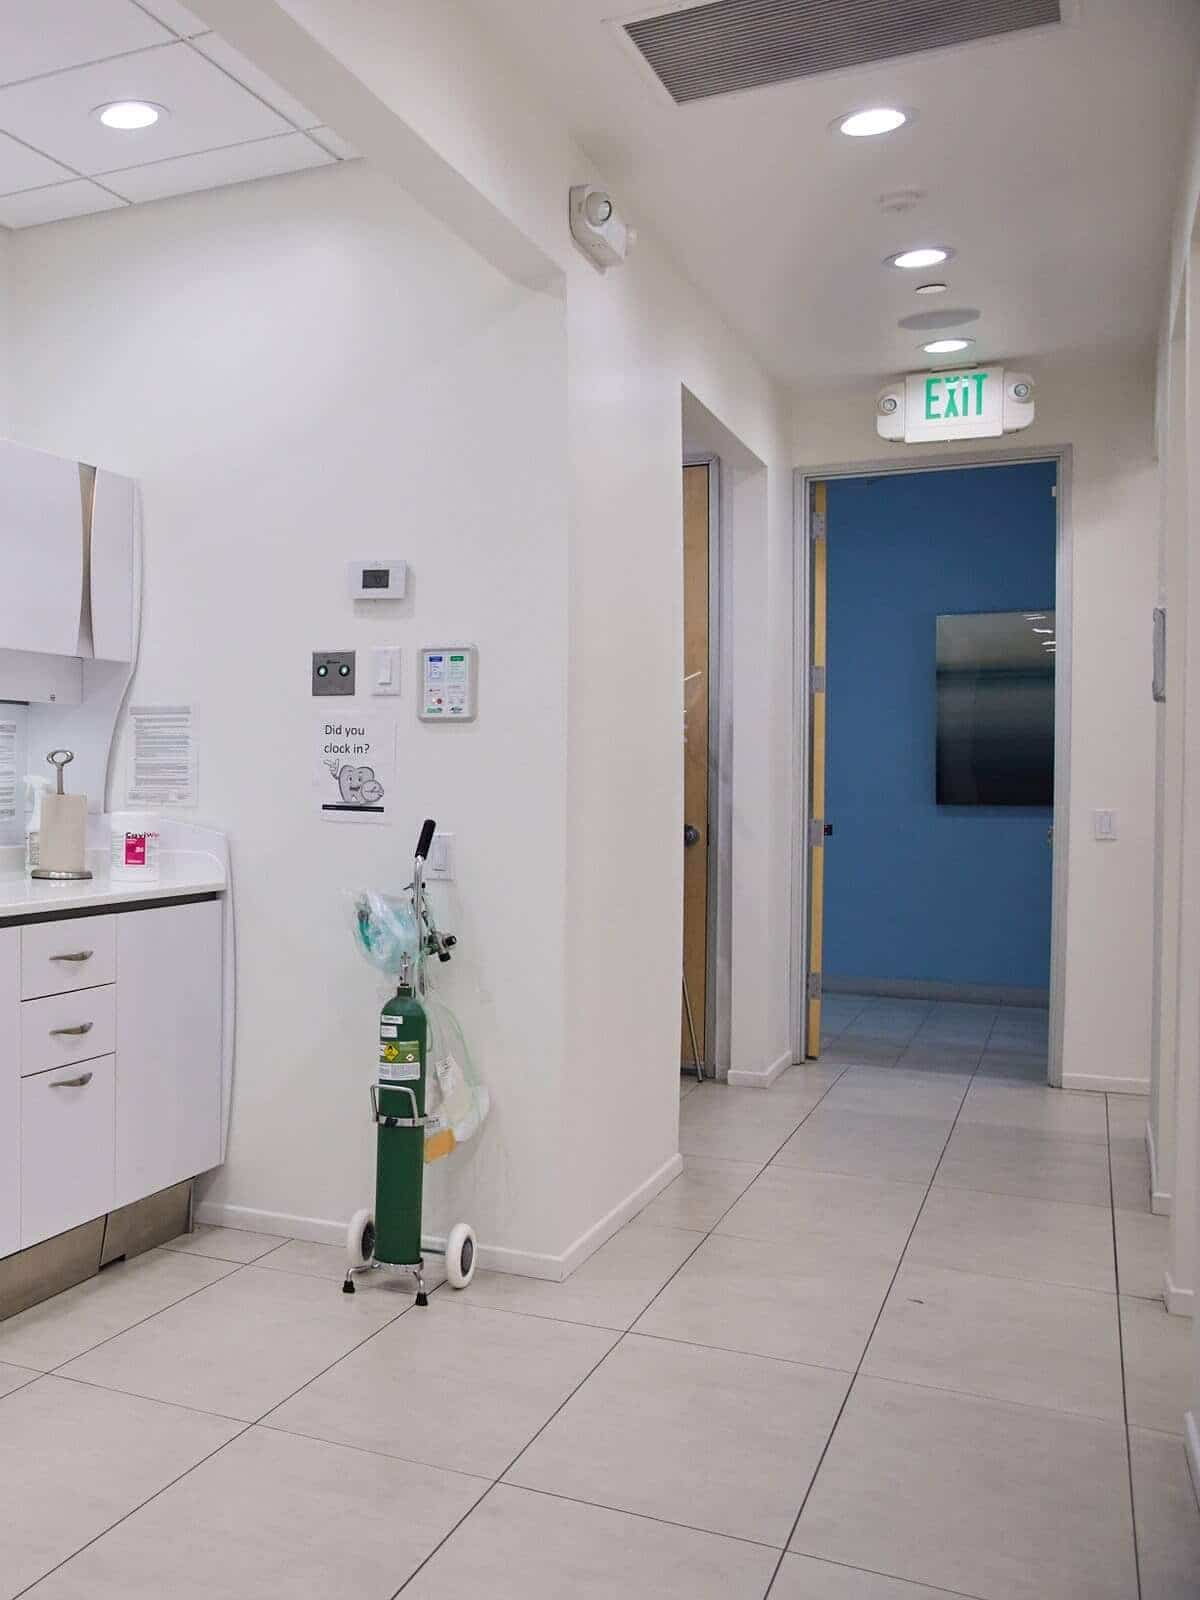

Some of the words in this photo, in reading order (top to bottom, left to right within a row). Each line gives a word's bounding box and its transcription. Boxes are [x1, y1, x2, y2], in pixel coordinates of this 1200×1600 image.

[924, 373, 989, 420] EXIT
[324, 724, 343, 735] Did
[345, 727, 365, 737] you
[324, 743, 351, 754] clock
[353, 743, 370, 754] in?
